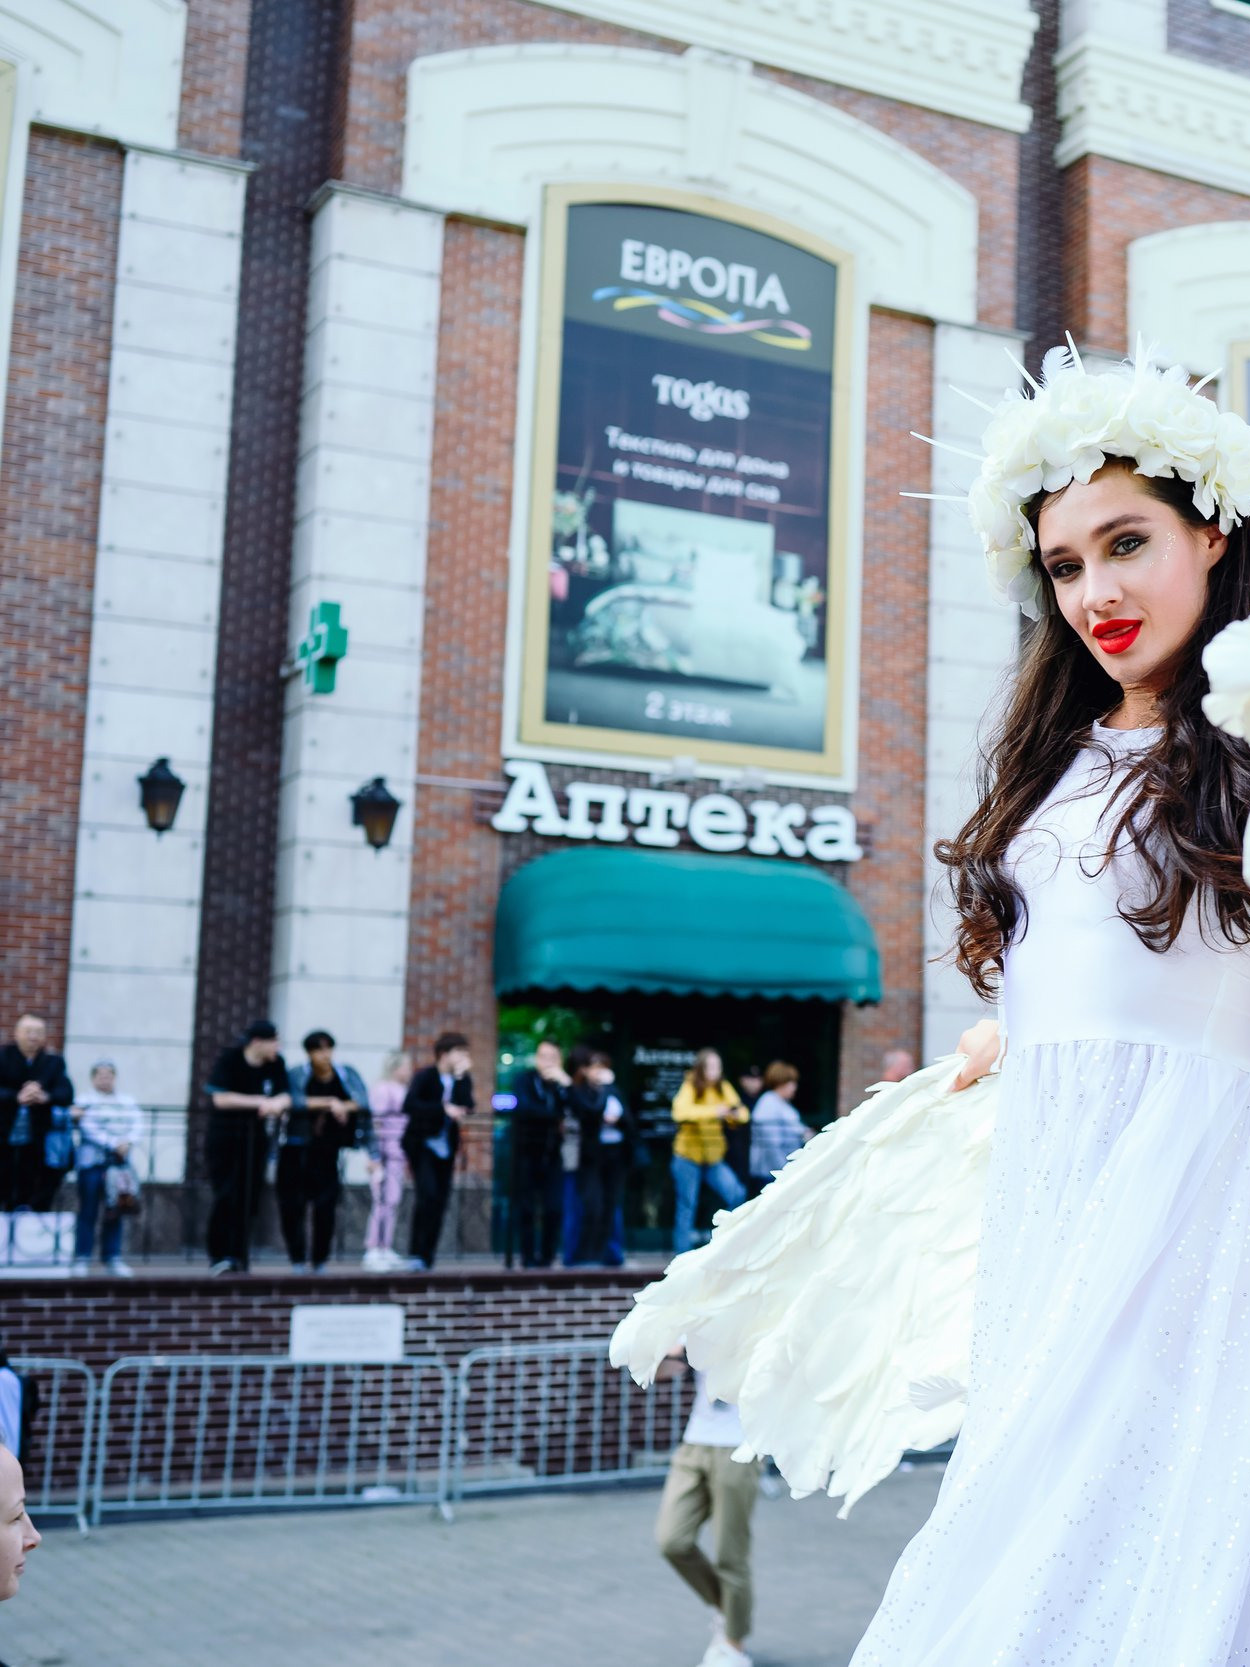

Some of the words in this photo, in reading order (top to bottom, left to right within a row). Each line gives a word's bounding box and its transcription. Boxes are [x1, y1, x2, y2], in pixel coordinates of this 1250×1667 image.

[621, 238, 790, 314] ЕВРОПА
[605, 425, 697, 463] Текстиль
[697, 447, 737, 470] для
[736, 454, 790, 480] дома
[612, 458, 631, 478] и
[631, 461, 706, 491] товары
[705, 475, 745, 496] для
[745, 482, 781, 504] сна
[645, 690, 665, 720] 2
[667, 701, 732, 728] этаж
[492, 760, 863, 862] Аптека
